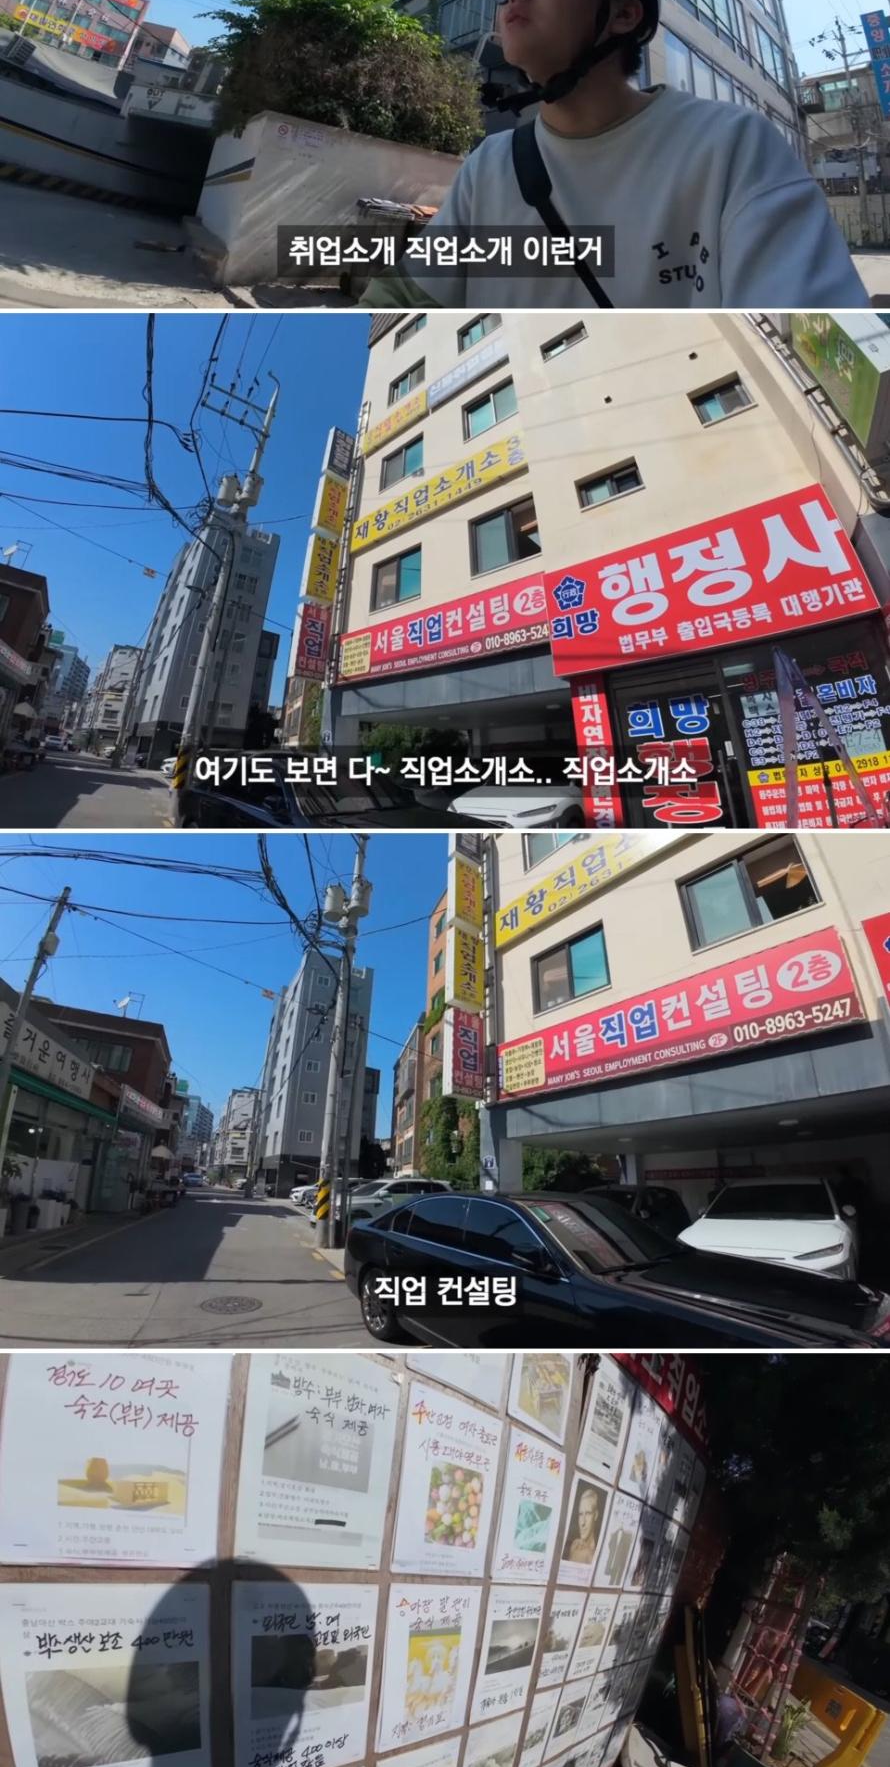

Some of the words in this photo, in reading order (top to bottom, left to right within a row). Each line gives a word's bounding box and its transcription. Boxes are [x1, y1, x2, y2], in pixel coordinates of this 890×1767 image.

[354, 450, 503, 540] 재왕직업소개소
[598, 500, 852, 626] 행정사
[304, 619, 325, 658] 직업
[374, 593, 511, 654] 서울직업컨설팅
[519, 588, 545, 610] 2층
[551, 609, 599, 641] 희망
[618, 627, 669, 655] 법무부
[676, 602, 772, 642] 출입국등록
[780, 577, 866, 617] 대행기관
[627, 696, 711, 738] 희망
[549, 964, 775, 1062] 서울직업컨설팅
[787, 954, 833, 989] 2층
[459, 1026, 478, 1073] 직업
[582, 1063, 603, 1079] SEOUL
[604, 1052, 652, 1074] EMPLOYMENT
[653, 1038, 706, 1061] CONSULTING
[733, 997, 852, 1044] 010-8963-5247
[47, 1365, 95, 1387] 경기도
[99, 1373, 125, 1390] 10
[131, 1377, 180, 1399] 여곳
[64, 1395, 152, 1429] 숙소(부부)
[157, 1412, 199, 1437] 제공
